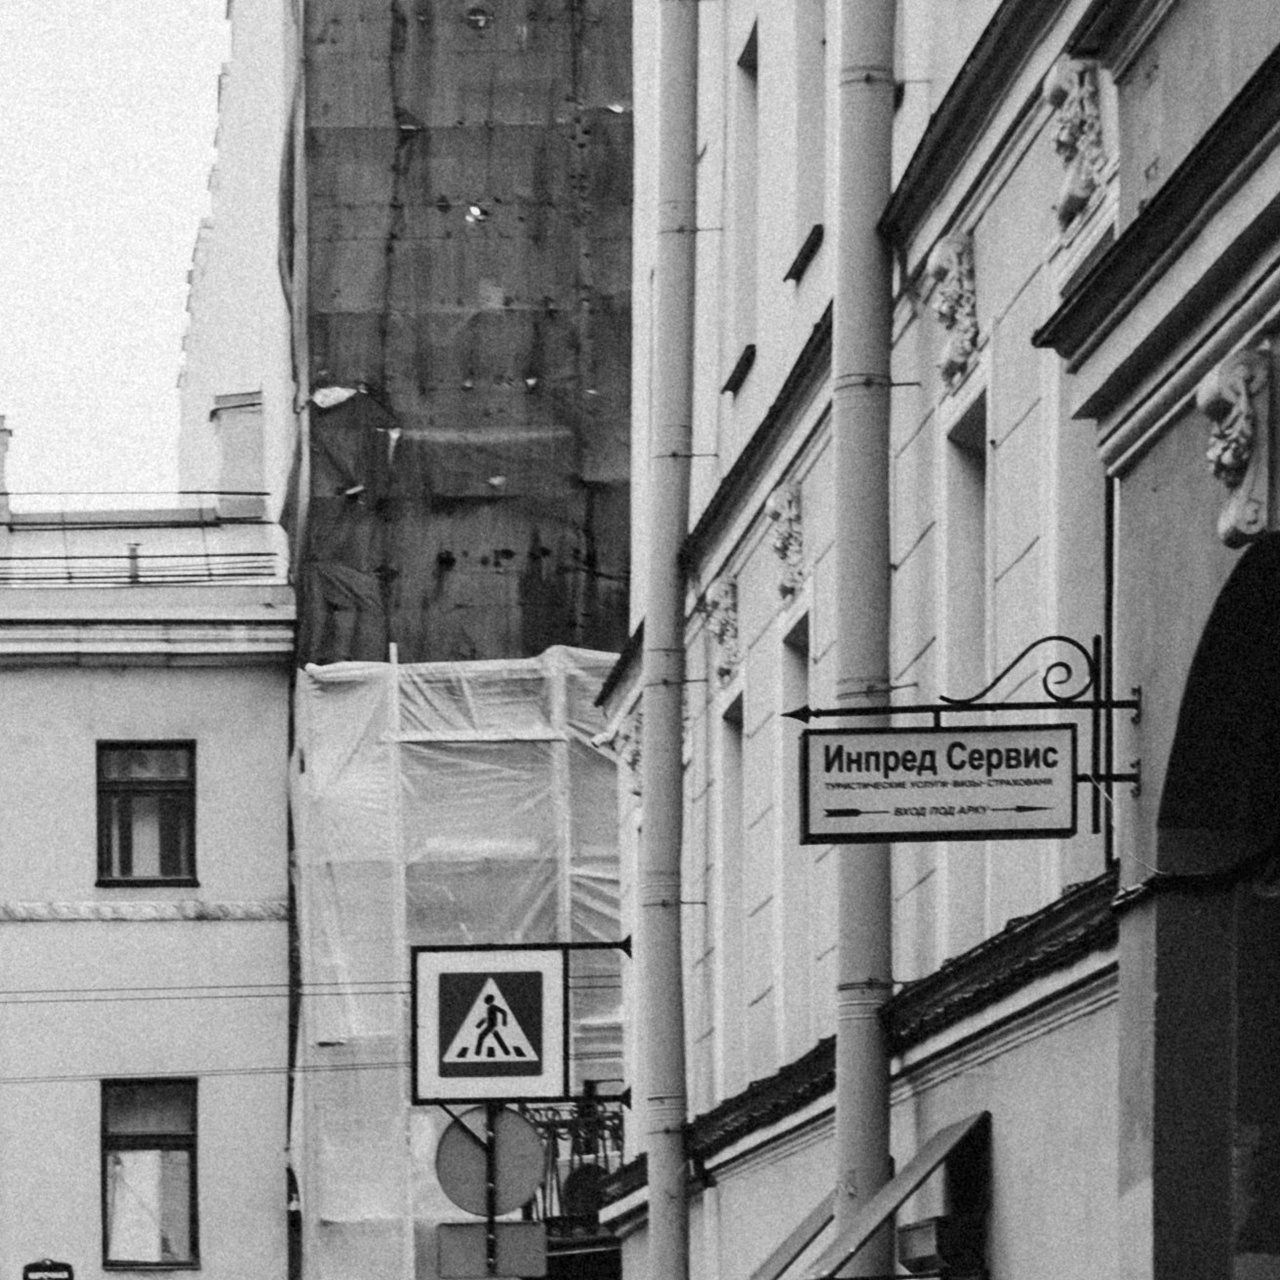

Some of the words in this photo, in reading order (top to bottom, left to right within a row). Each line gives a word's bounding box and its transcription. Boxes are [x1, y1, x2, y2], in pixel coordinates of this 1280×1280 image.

[824, 744, 937, 779] Инпред
[946, 741, 1059, 777] Сервис
[893, 806, 926, 817] ВХОД
[928, 805, 956, 816] ПОД
[957, 804, 990, 815] АРКУ
